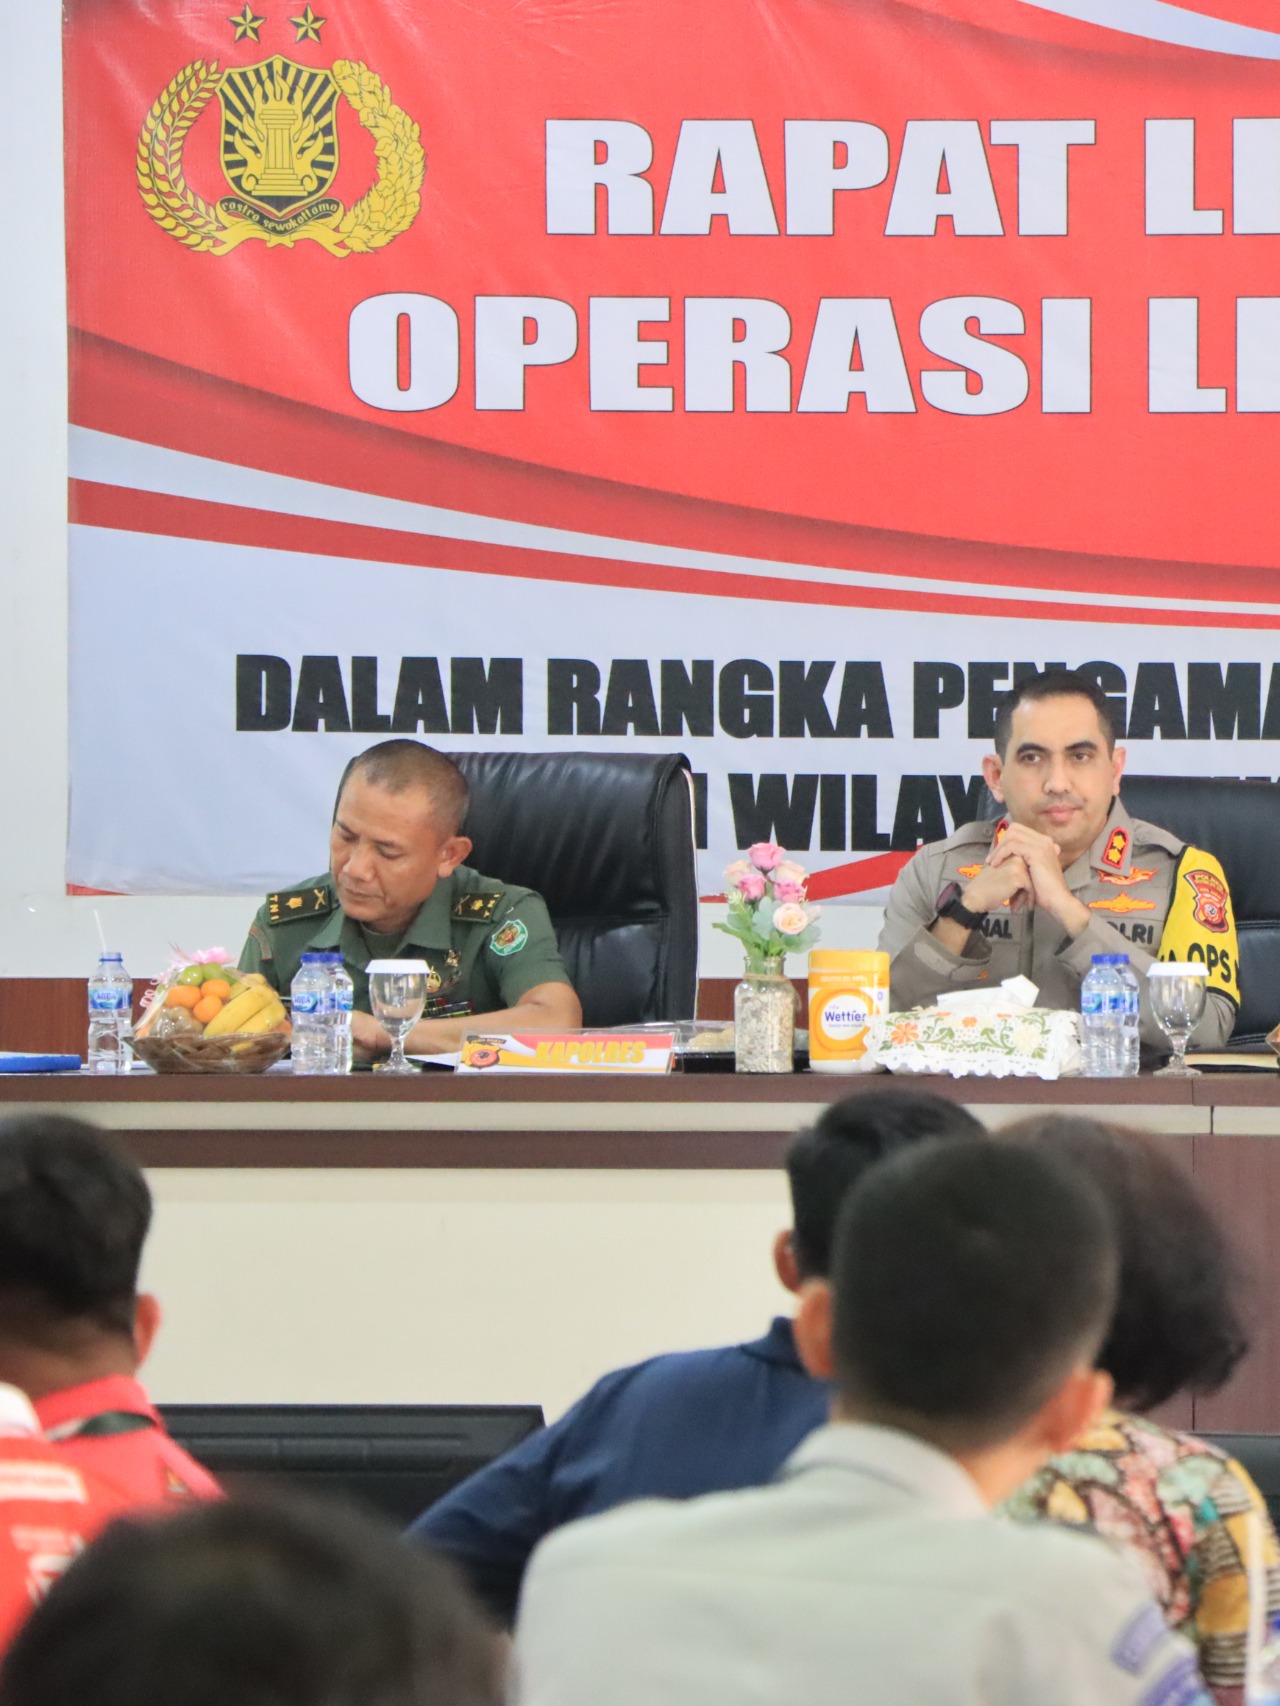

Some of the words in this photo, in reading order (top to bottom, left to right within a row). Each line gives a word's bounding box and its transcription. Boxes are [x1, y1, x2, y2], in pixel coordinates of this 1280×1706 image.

[545, 119, 1097, 236] RAPAT
[347, 292, 1093, 416] OPERASI
[235, 654, 524, 734] DALAM
[547, 658, 894, 740] RANGKA
[533, 1041, 647, 1065] KAPOLRES
